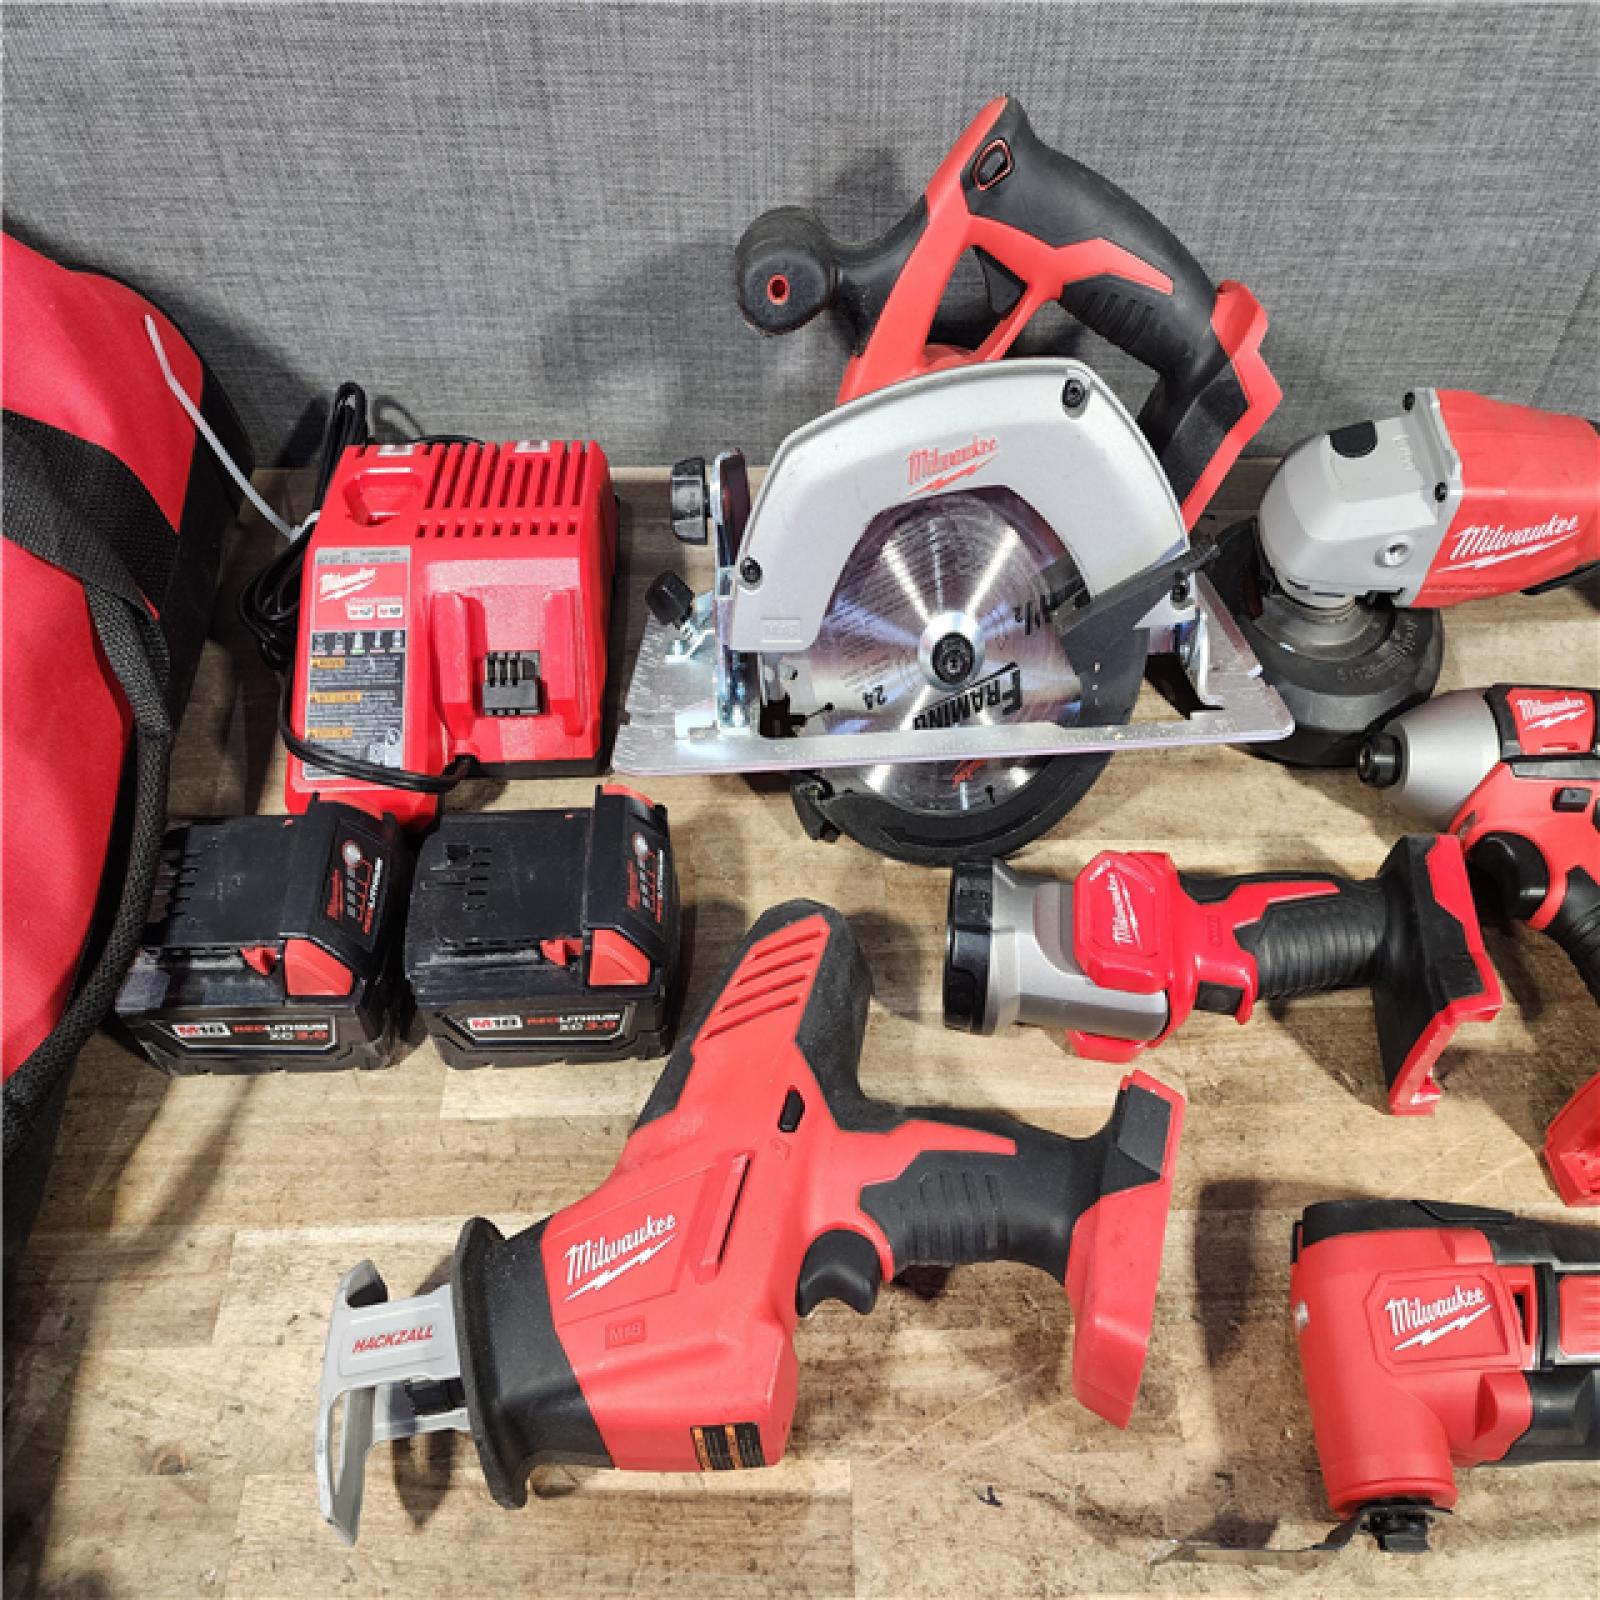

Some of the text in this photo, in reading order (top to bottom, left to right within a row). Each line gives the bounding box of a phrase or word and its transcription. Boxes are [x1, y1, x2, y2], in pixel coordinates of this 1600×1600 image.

[906, 433, 998, 485] Milwaukee
[1450, 513, 1578, 560] Milwaukee
[1516, 696, 1584, 721] Milwaukee
[1107, 871, 1132, 945] Milwaukee
[563, 1213, 675, 1286] Milwaukee
[1384, 1285, 1486, 1336] Milwaukee
[352, 1324, 432, 1354] HACKZALL
